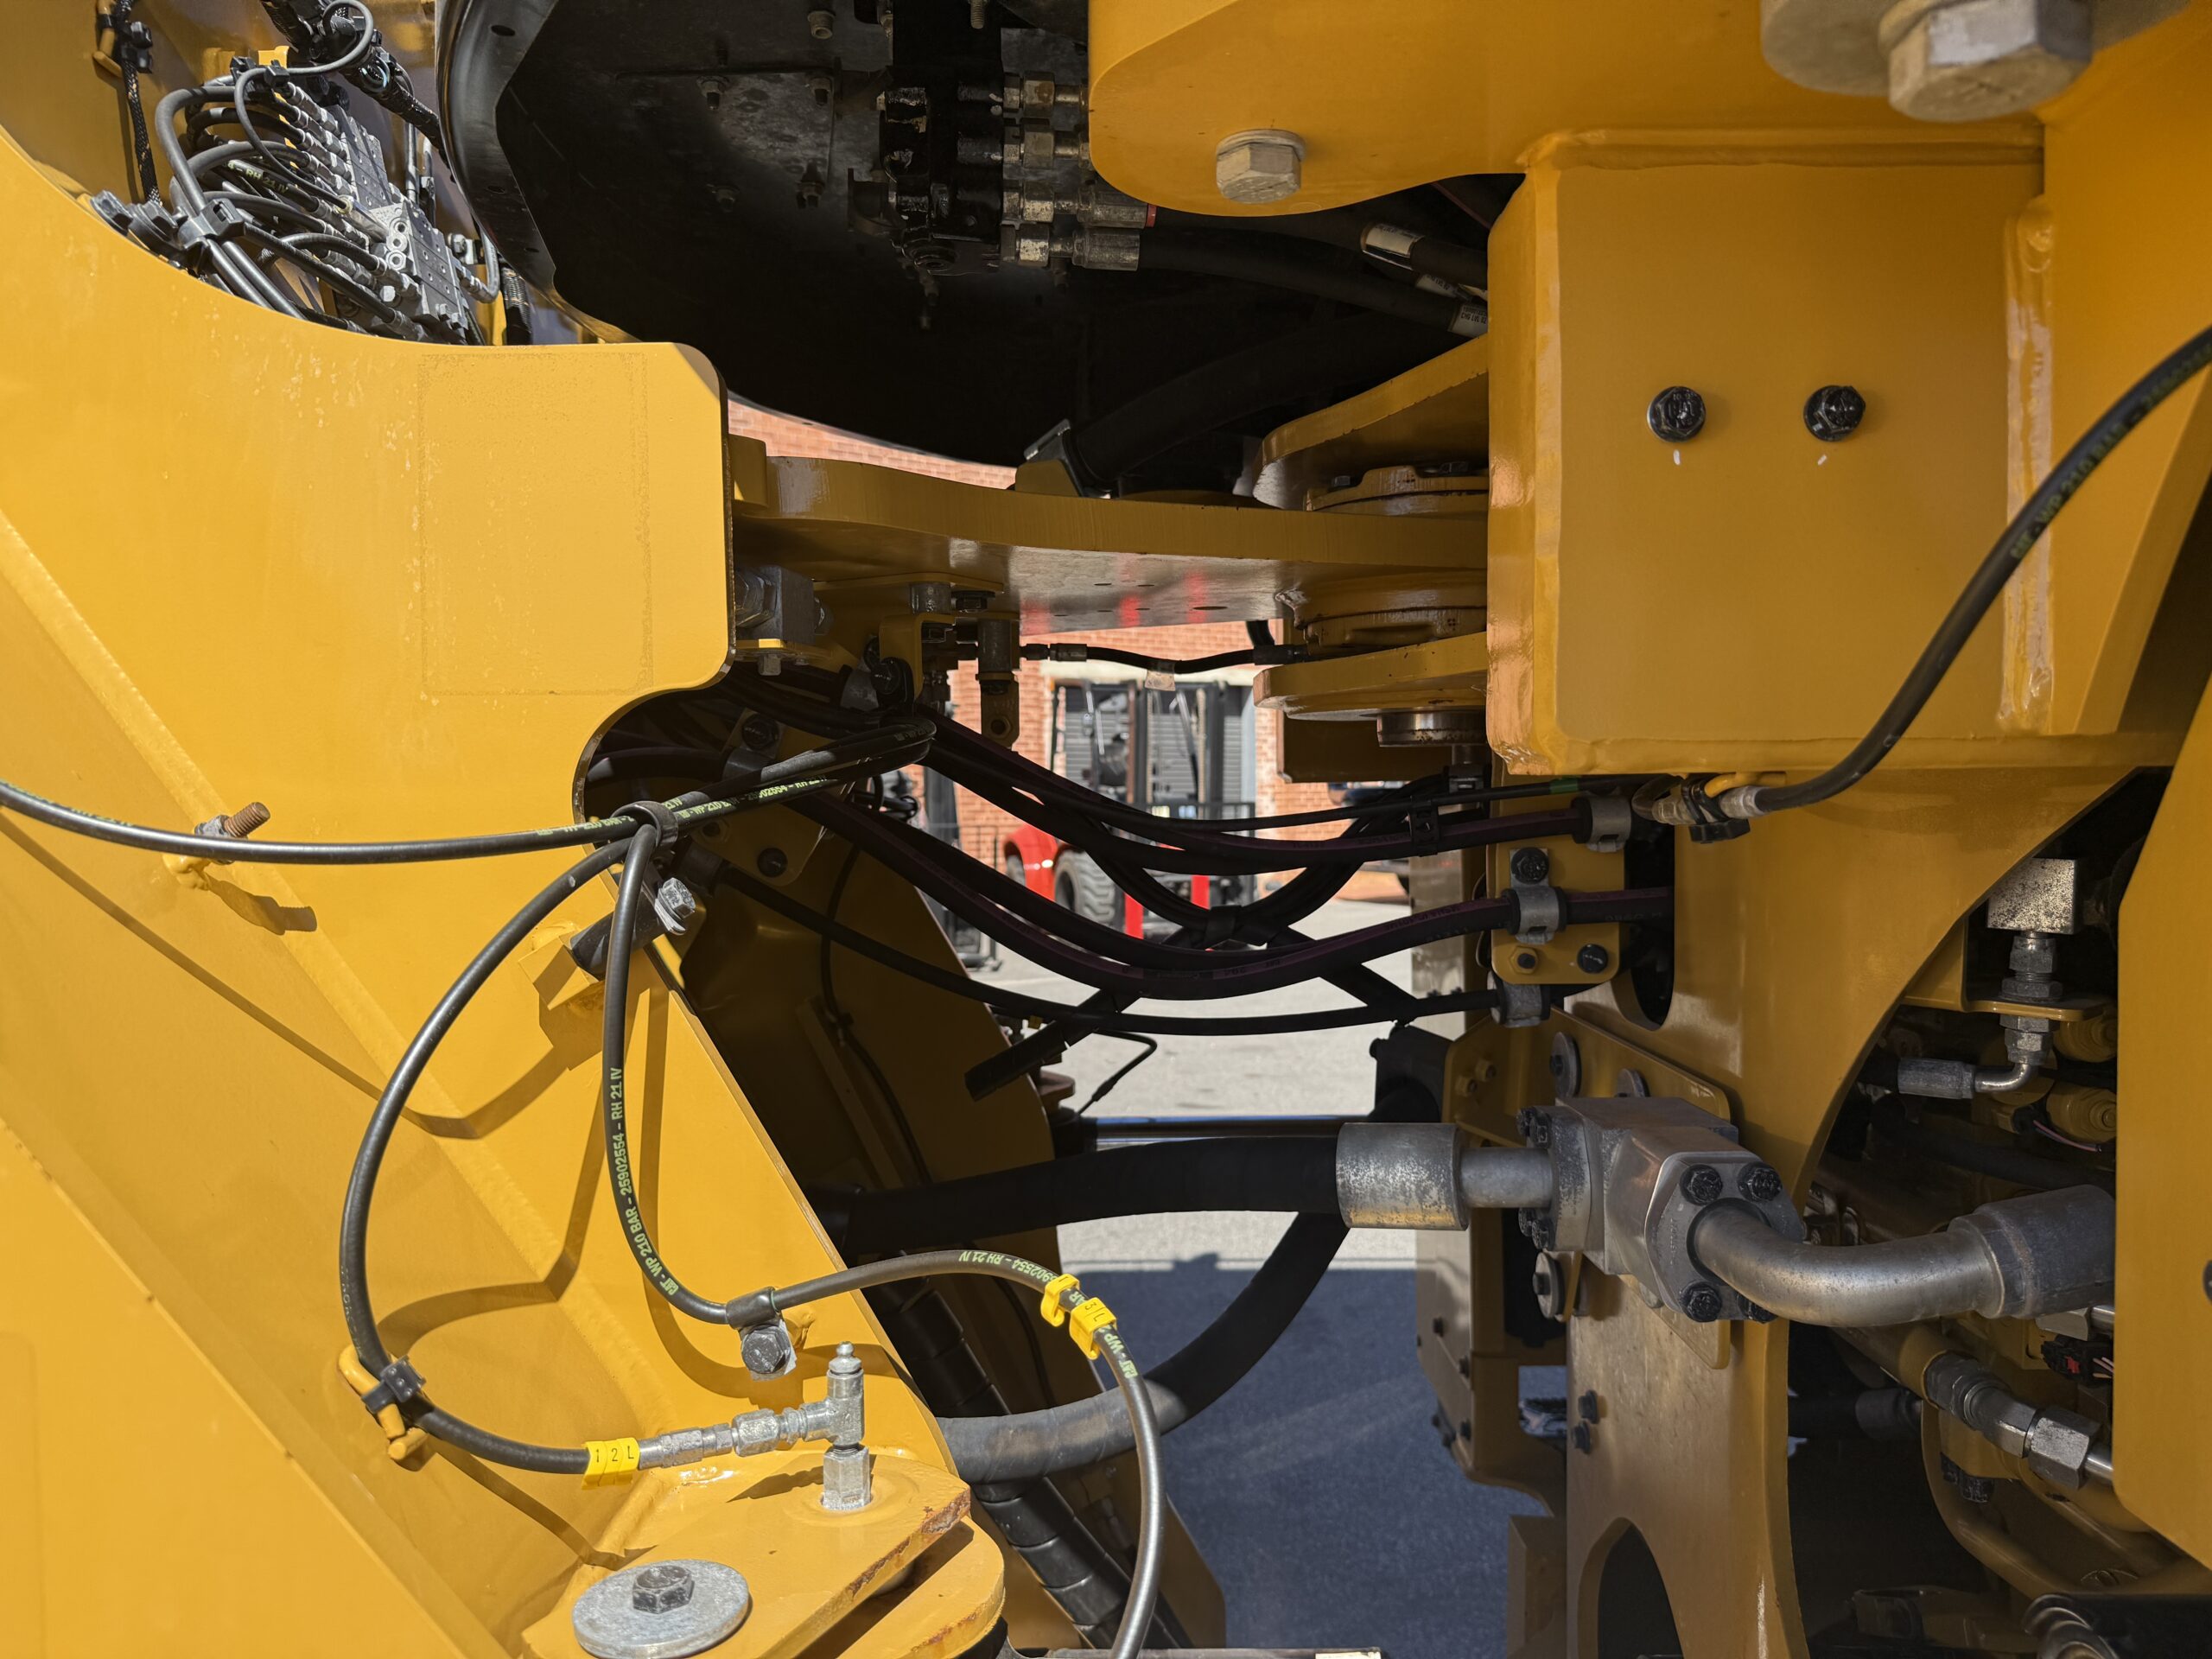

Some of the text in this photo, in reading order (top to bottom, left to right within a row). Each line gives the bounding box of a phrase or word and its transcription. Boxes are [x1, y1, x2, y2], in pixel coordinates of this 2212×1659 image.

[610, 1067, 622, 1080] IV
[610, 1081, 622, 1100] 21
[611, 1101, 623, 1121] RH
[612, 1133, 632, 1196] 25902554
[626, 1205, 643, 1234] BAR
[634, 1233, 652, 1257] 210
[958, 1251, 970, 1262] IV
[971, 1251, 989, 1263] 21
[986, 1253, 1005, 1265] RH
[645, 1257, 663, 1277] WP
[659, 1277, 679, 1296] CAT
[1103, 1333, 1125, 1355] WP
